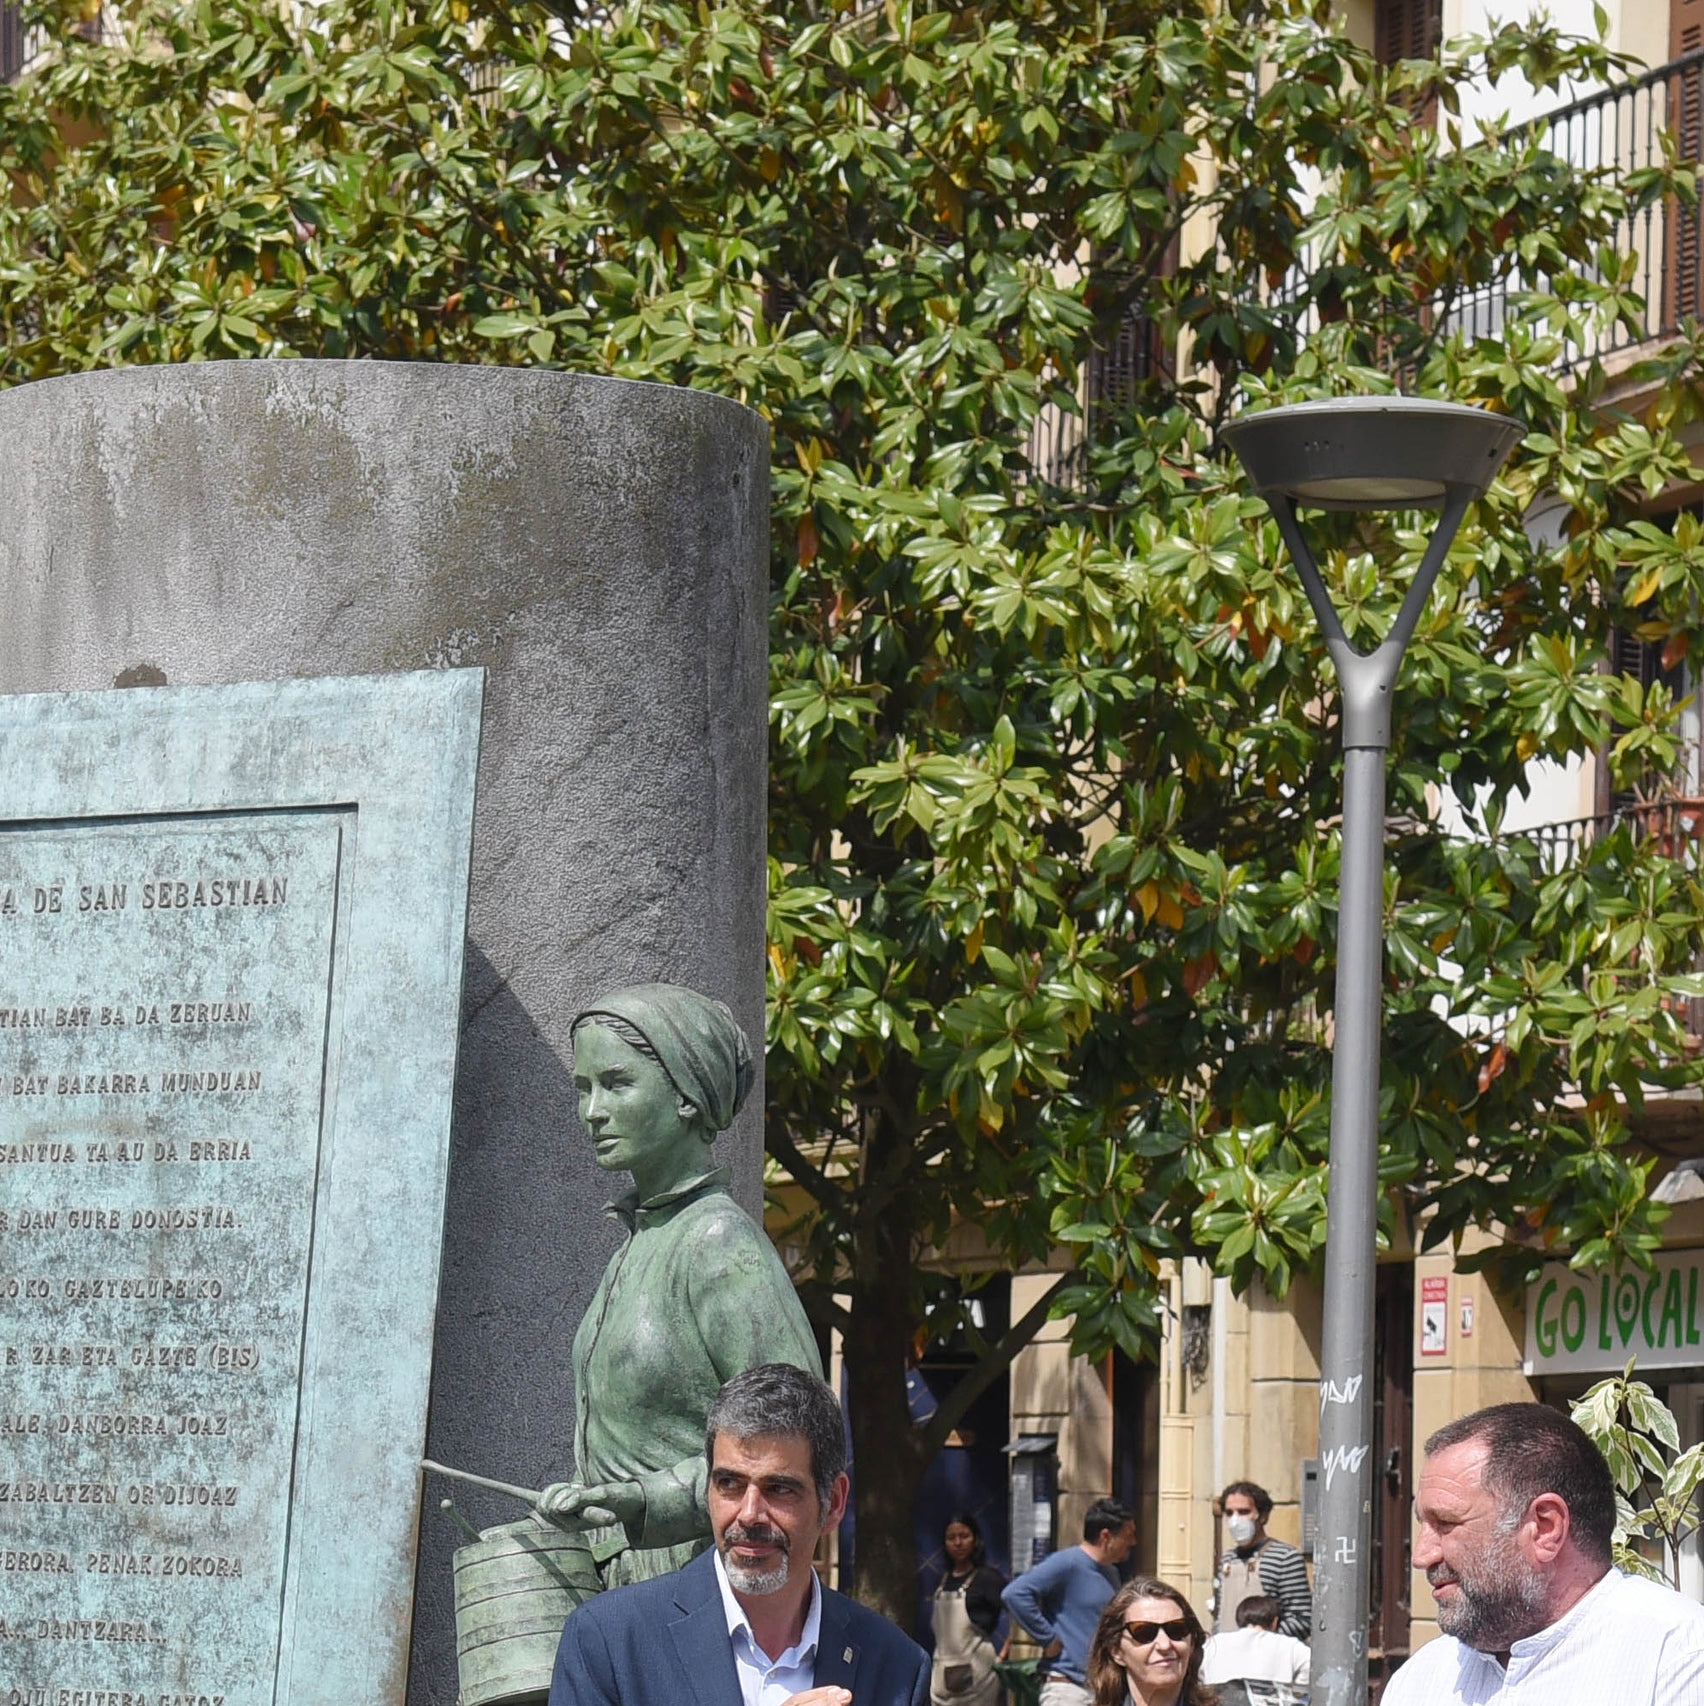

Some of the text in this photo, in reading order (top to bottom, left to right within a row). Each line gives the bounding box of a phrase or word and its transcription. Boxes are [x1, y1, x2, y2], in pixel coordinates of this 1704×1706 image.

[34, 886, 62, 915] DE
[78, 884, 126, 911] SAN
[141, 877, 287, 909] SEBASTIAN
[54, 1006, 91, 1027] BAT
[100, 1005, 126, 1026] BA
[135, 1004, 160, 1025] DA
[170, 1002, 251, 1024] ZERUAN
[12, 1074, 48, 1096] BAT
[56, 1072, 151, 1095] BAKARRA
[161, 1070, 261, 1092] MUNDUAN
[86, 1142, 108, 1162] TA
[117, 1142, 144, 1162] AU
[153, 1141, 178, 1162] DA
[189, 1139, 252, 1161] ERRIA
[19, 1210, 57, 1229] DAN
[68, 1209, 121, 1229] GURE
[1536, 1267, 1700, 1358] GO LOCAL
[32, 1345, 71, 1365] ZAR
[82, 1346, 117, 1366] ETA
[132, 1346, 197, 1366] GAZTE
[209, 1343, 260, 1370] (BIS)
[58, 1413, 167, 1435] DANBORRA
[177, 1415, 228, 1435] JOAZ
[128, 1484, 155, 1505] OR
[86, 1553, 152, 1575] PENAK
[162, 1555, 243, 1577] ZOKORA
